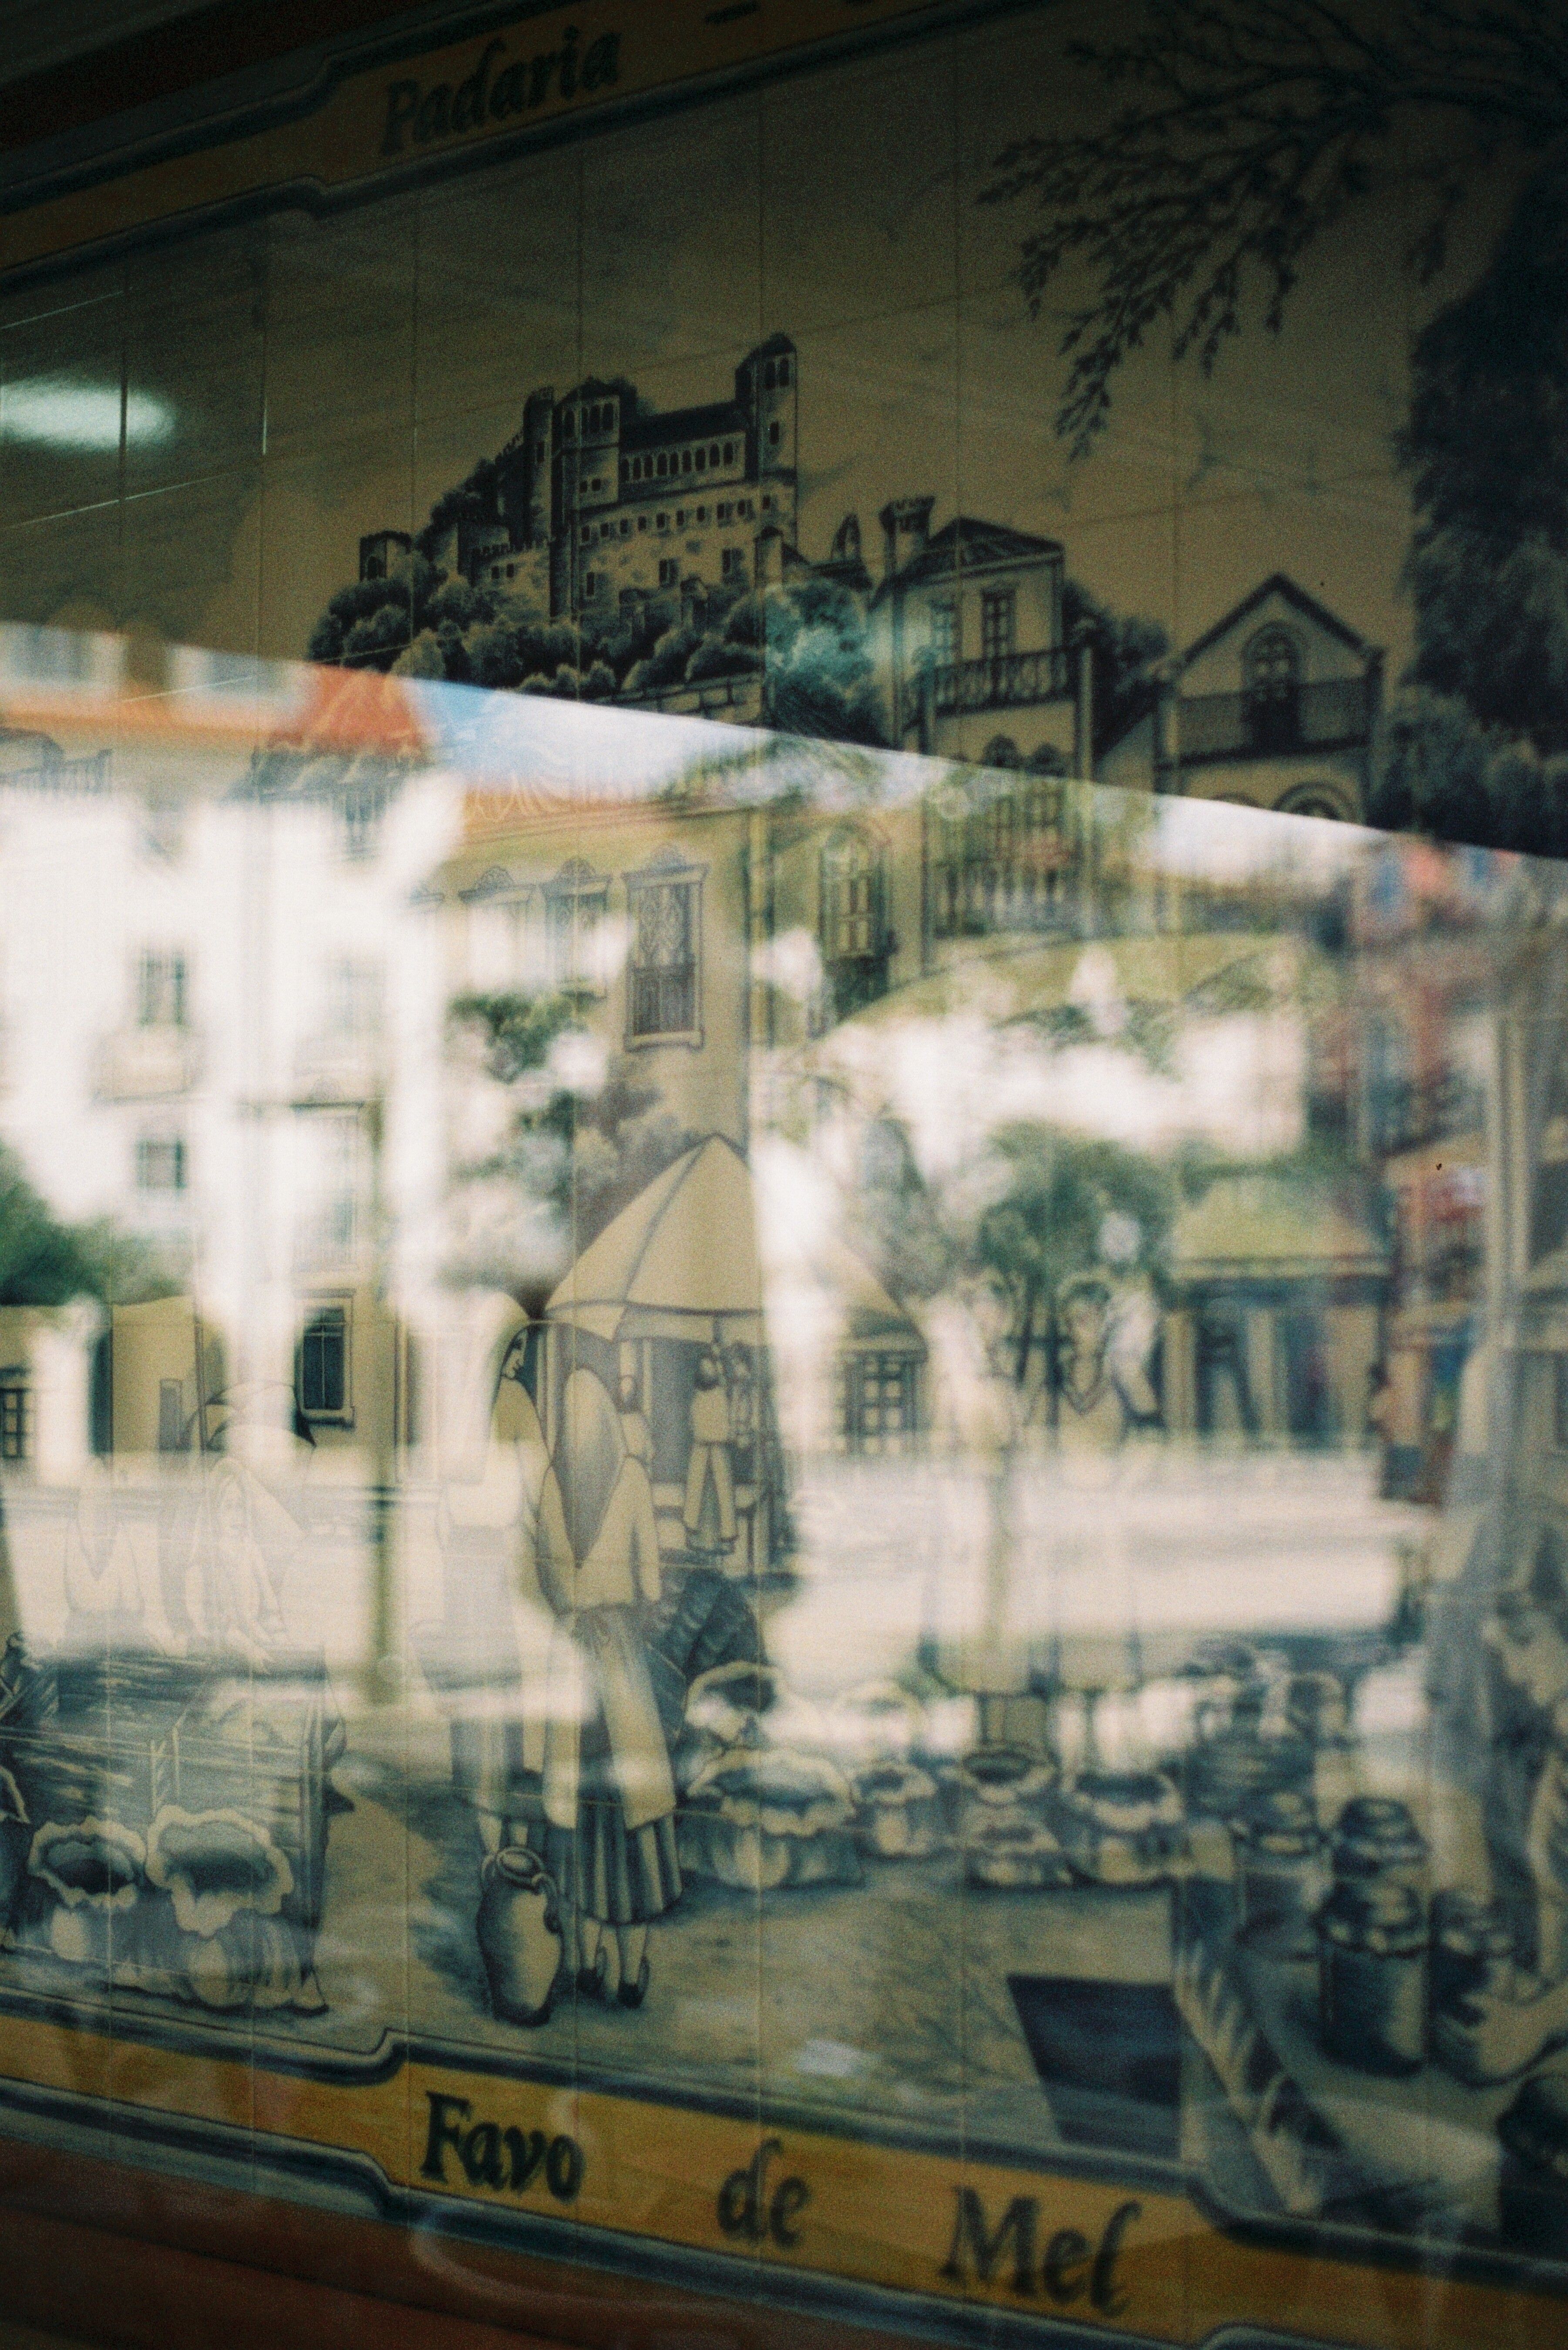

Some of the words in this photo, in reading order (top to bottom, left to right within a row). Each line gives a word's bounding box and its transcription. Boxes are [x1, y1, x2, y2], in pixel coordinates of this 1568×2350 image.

[382, 25, 620, 155] Padaria
[420, 2090, 585, 2205] Favo
[717, 2137, 808, 2249] de
[939, 2185, 1142, 2317] Mel
